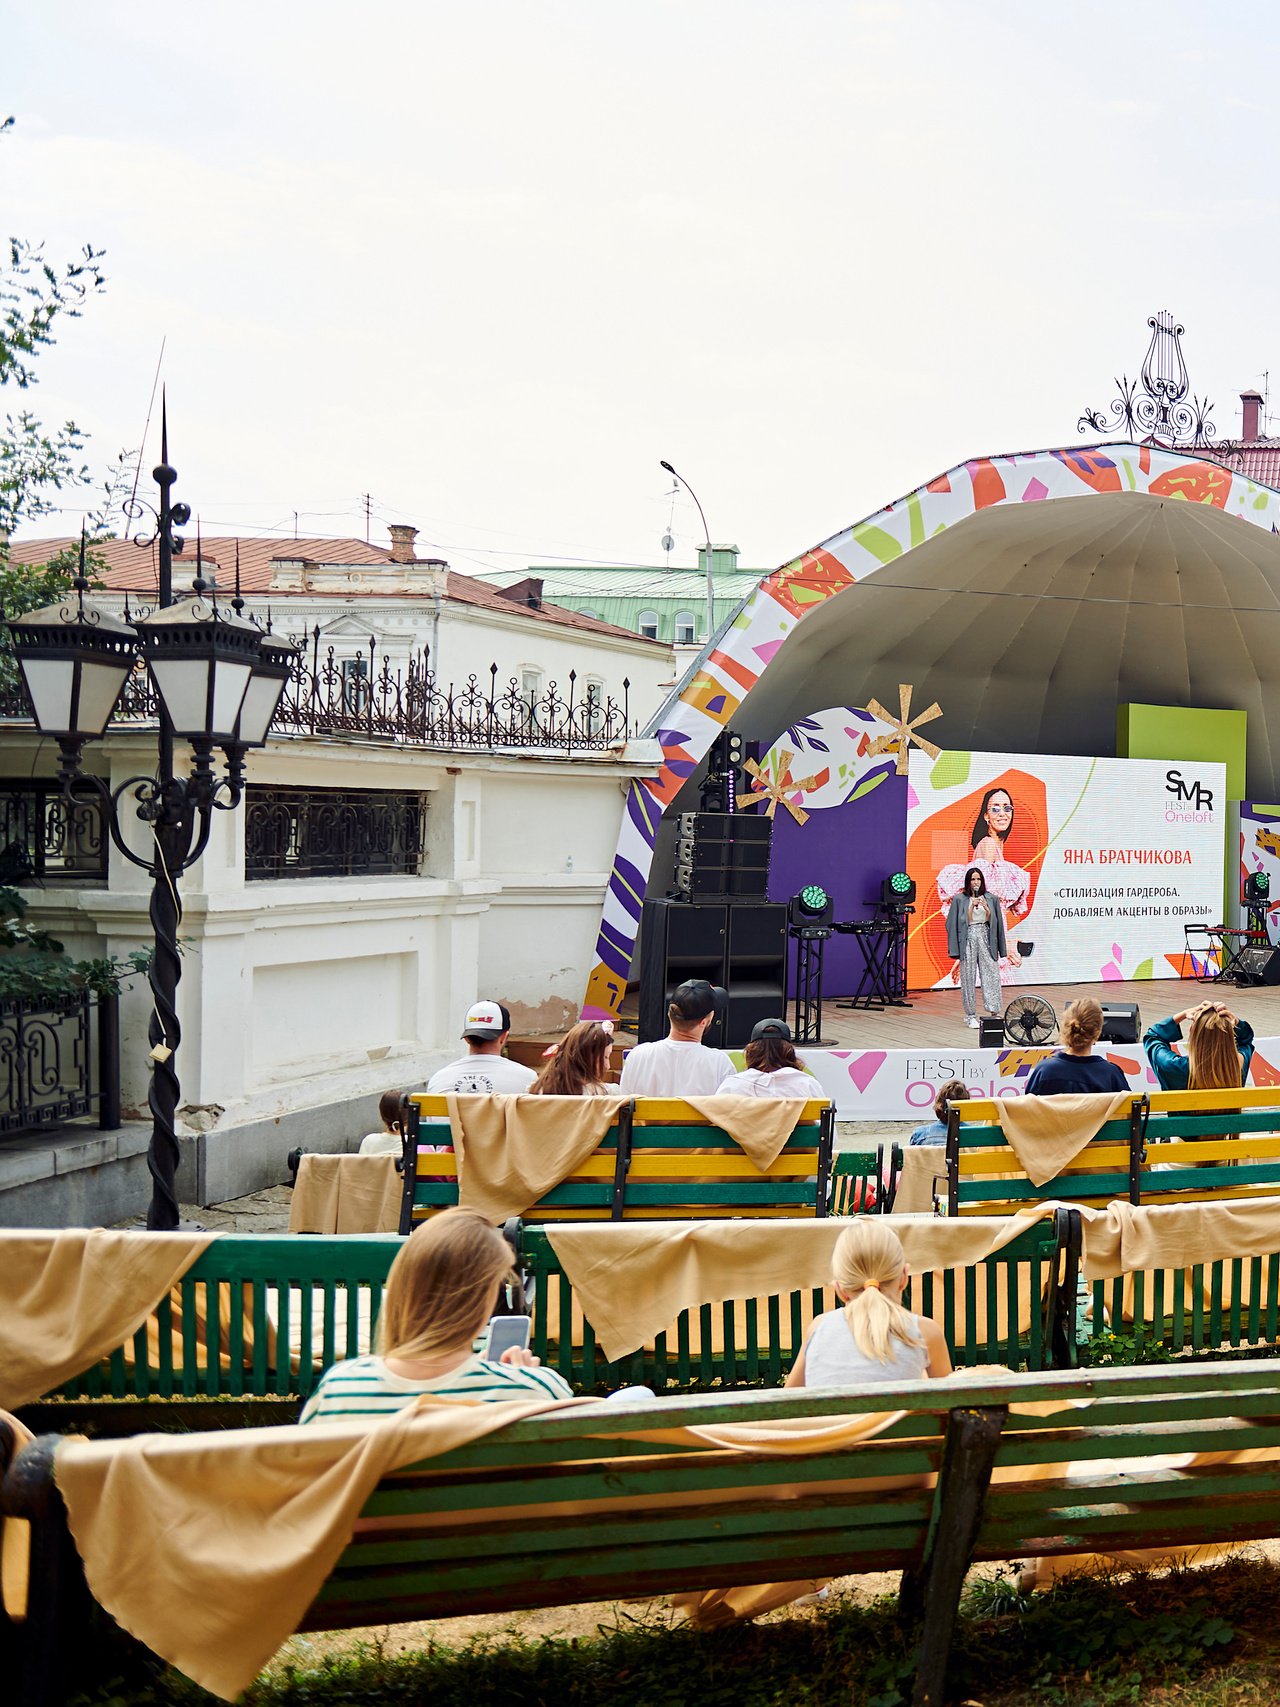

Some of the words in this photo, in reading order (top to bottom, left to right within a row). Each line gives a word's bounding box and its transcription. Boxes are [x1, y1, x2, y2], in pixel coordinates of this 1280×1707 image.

[1165, 769, 1214, 811] SMR
[1164, 810, 1214, 823] Oneloft
[1063, 849, 1095, 864] ЯНА
[1099, 849, 1192, 865] БРАТЧИКОВА
[1053, 887, 1124, 899] «СТИЛИЗАЦИЯ
[1126, 887, 1181, 899] ГАРДЕРОБА.
[1053, 907, 1114, 920] ДОБАВЛЯЕМ
[1116, 906, 1161, 918] АКЦЕНТЫ
[1164, 906, 1170, 916] В
[1172, 905, 1213, 916] ОБРАЗЫ»
[906, 1058, 972, 1080] FEST
[969, 1067, 988, 1079] BY
